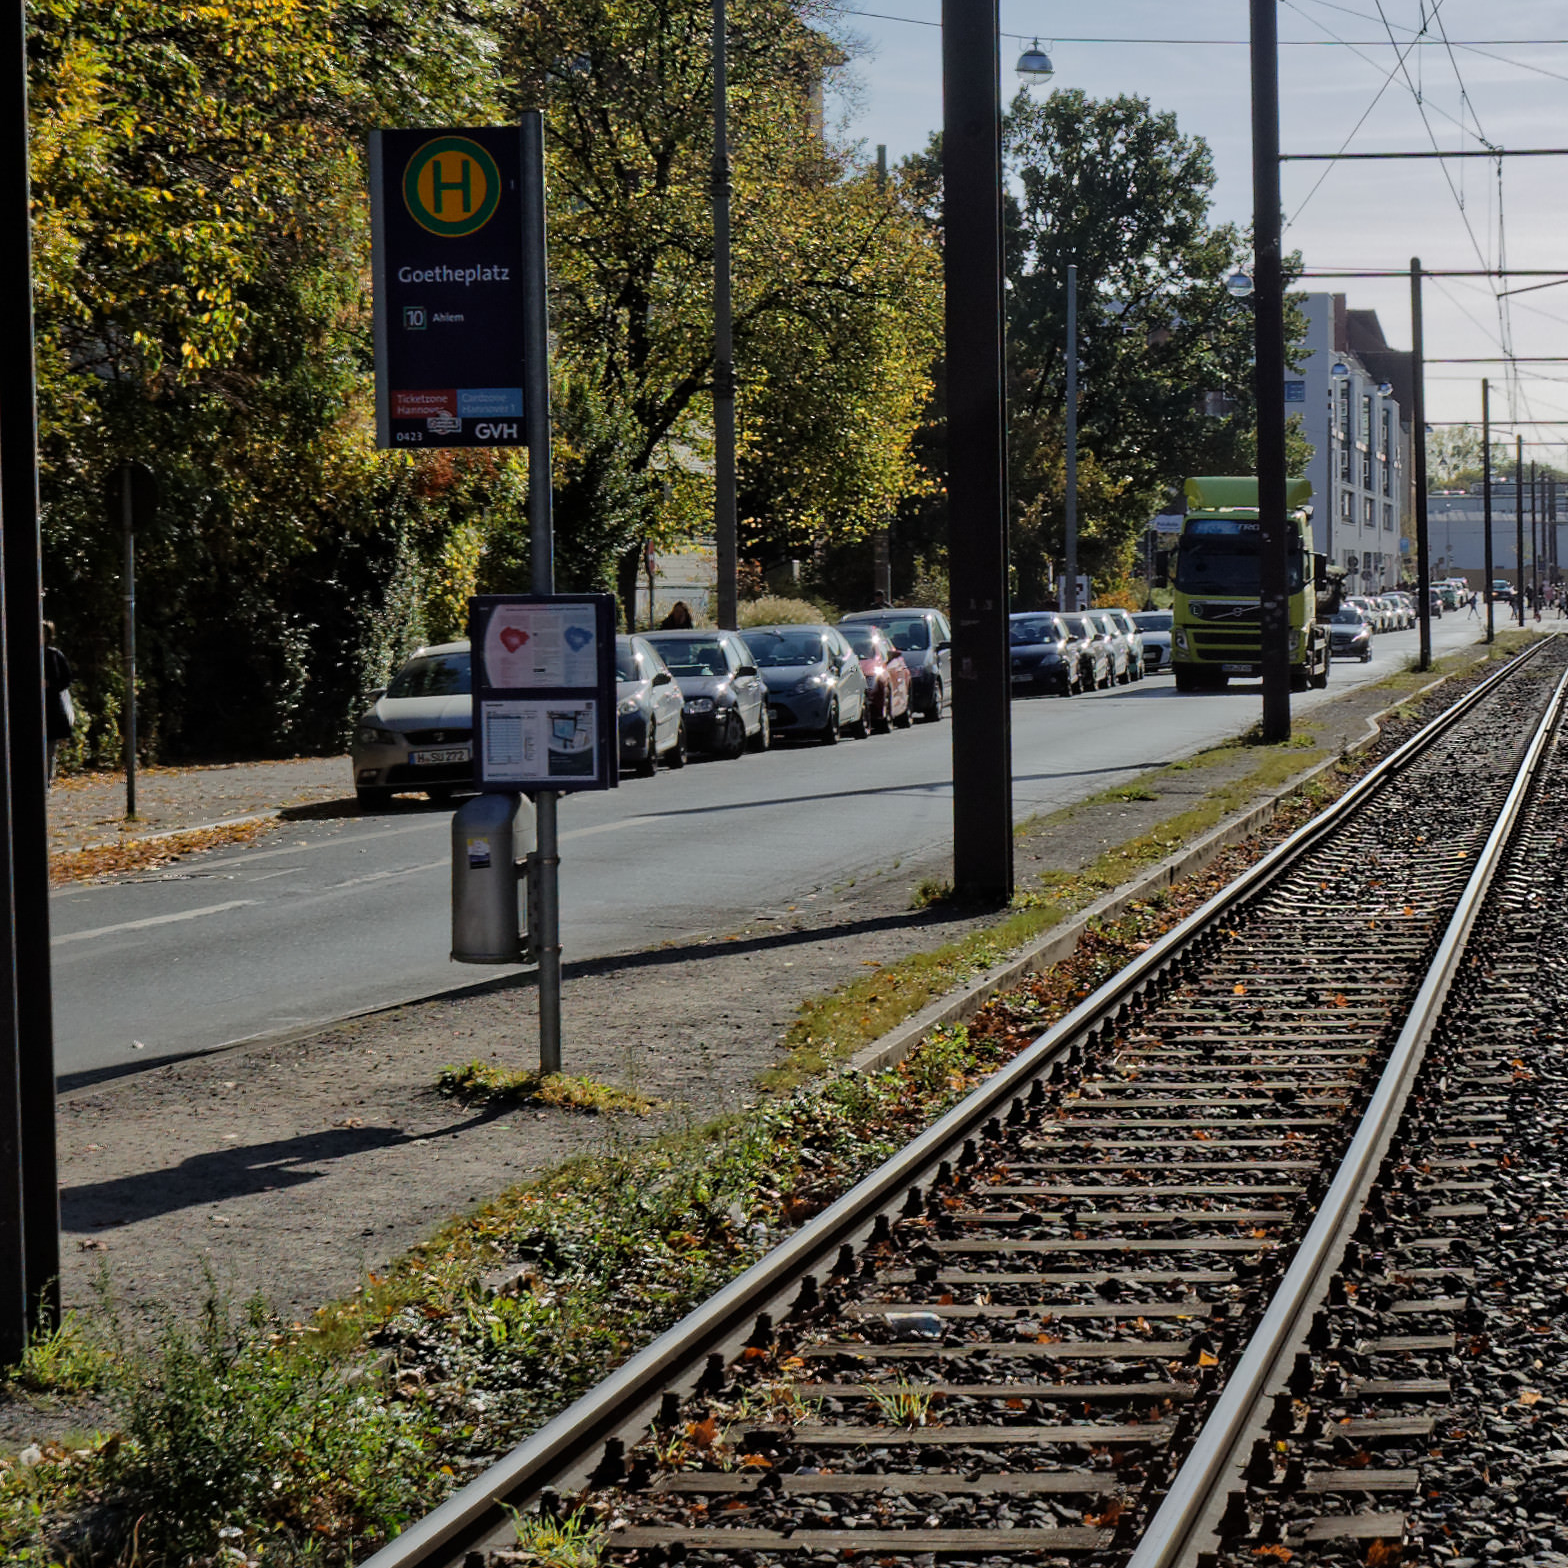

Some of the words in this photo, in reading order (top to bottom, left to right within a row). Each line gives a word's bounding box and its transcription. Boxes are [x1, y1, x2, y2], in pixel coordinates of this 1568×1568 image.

[432, 159, 472, 214] H
[398, 264, 511, 286] Goetheplatz
[406, 310, 424, 326] 10
[432, 312, 464, 323] Ahlem
[396, 394, 448, 404] Ticketzone
[396, 431, 423, 442] 0423
[475, 423, 519, 440] GVH
